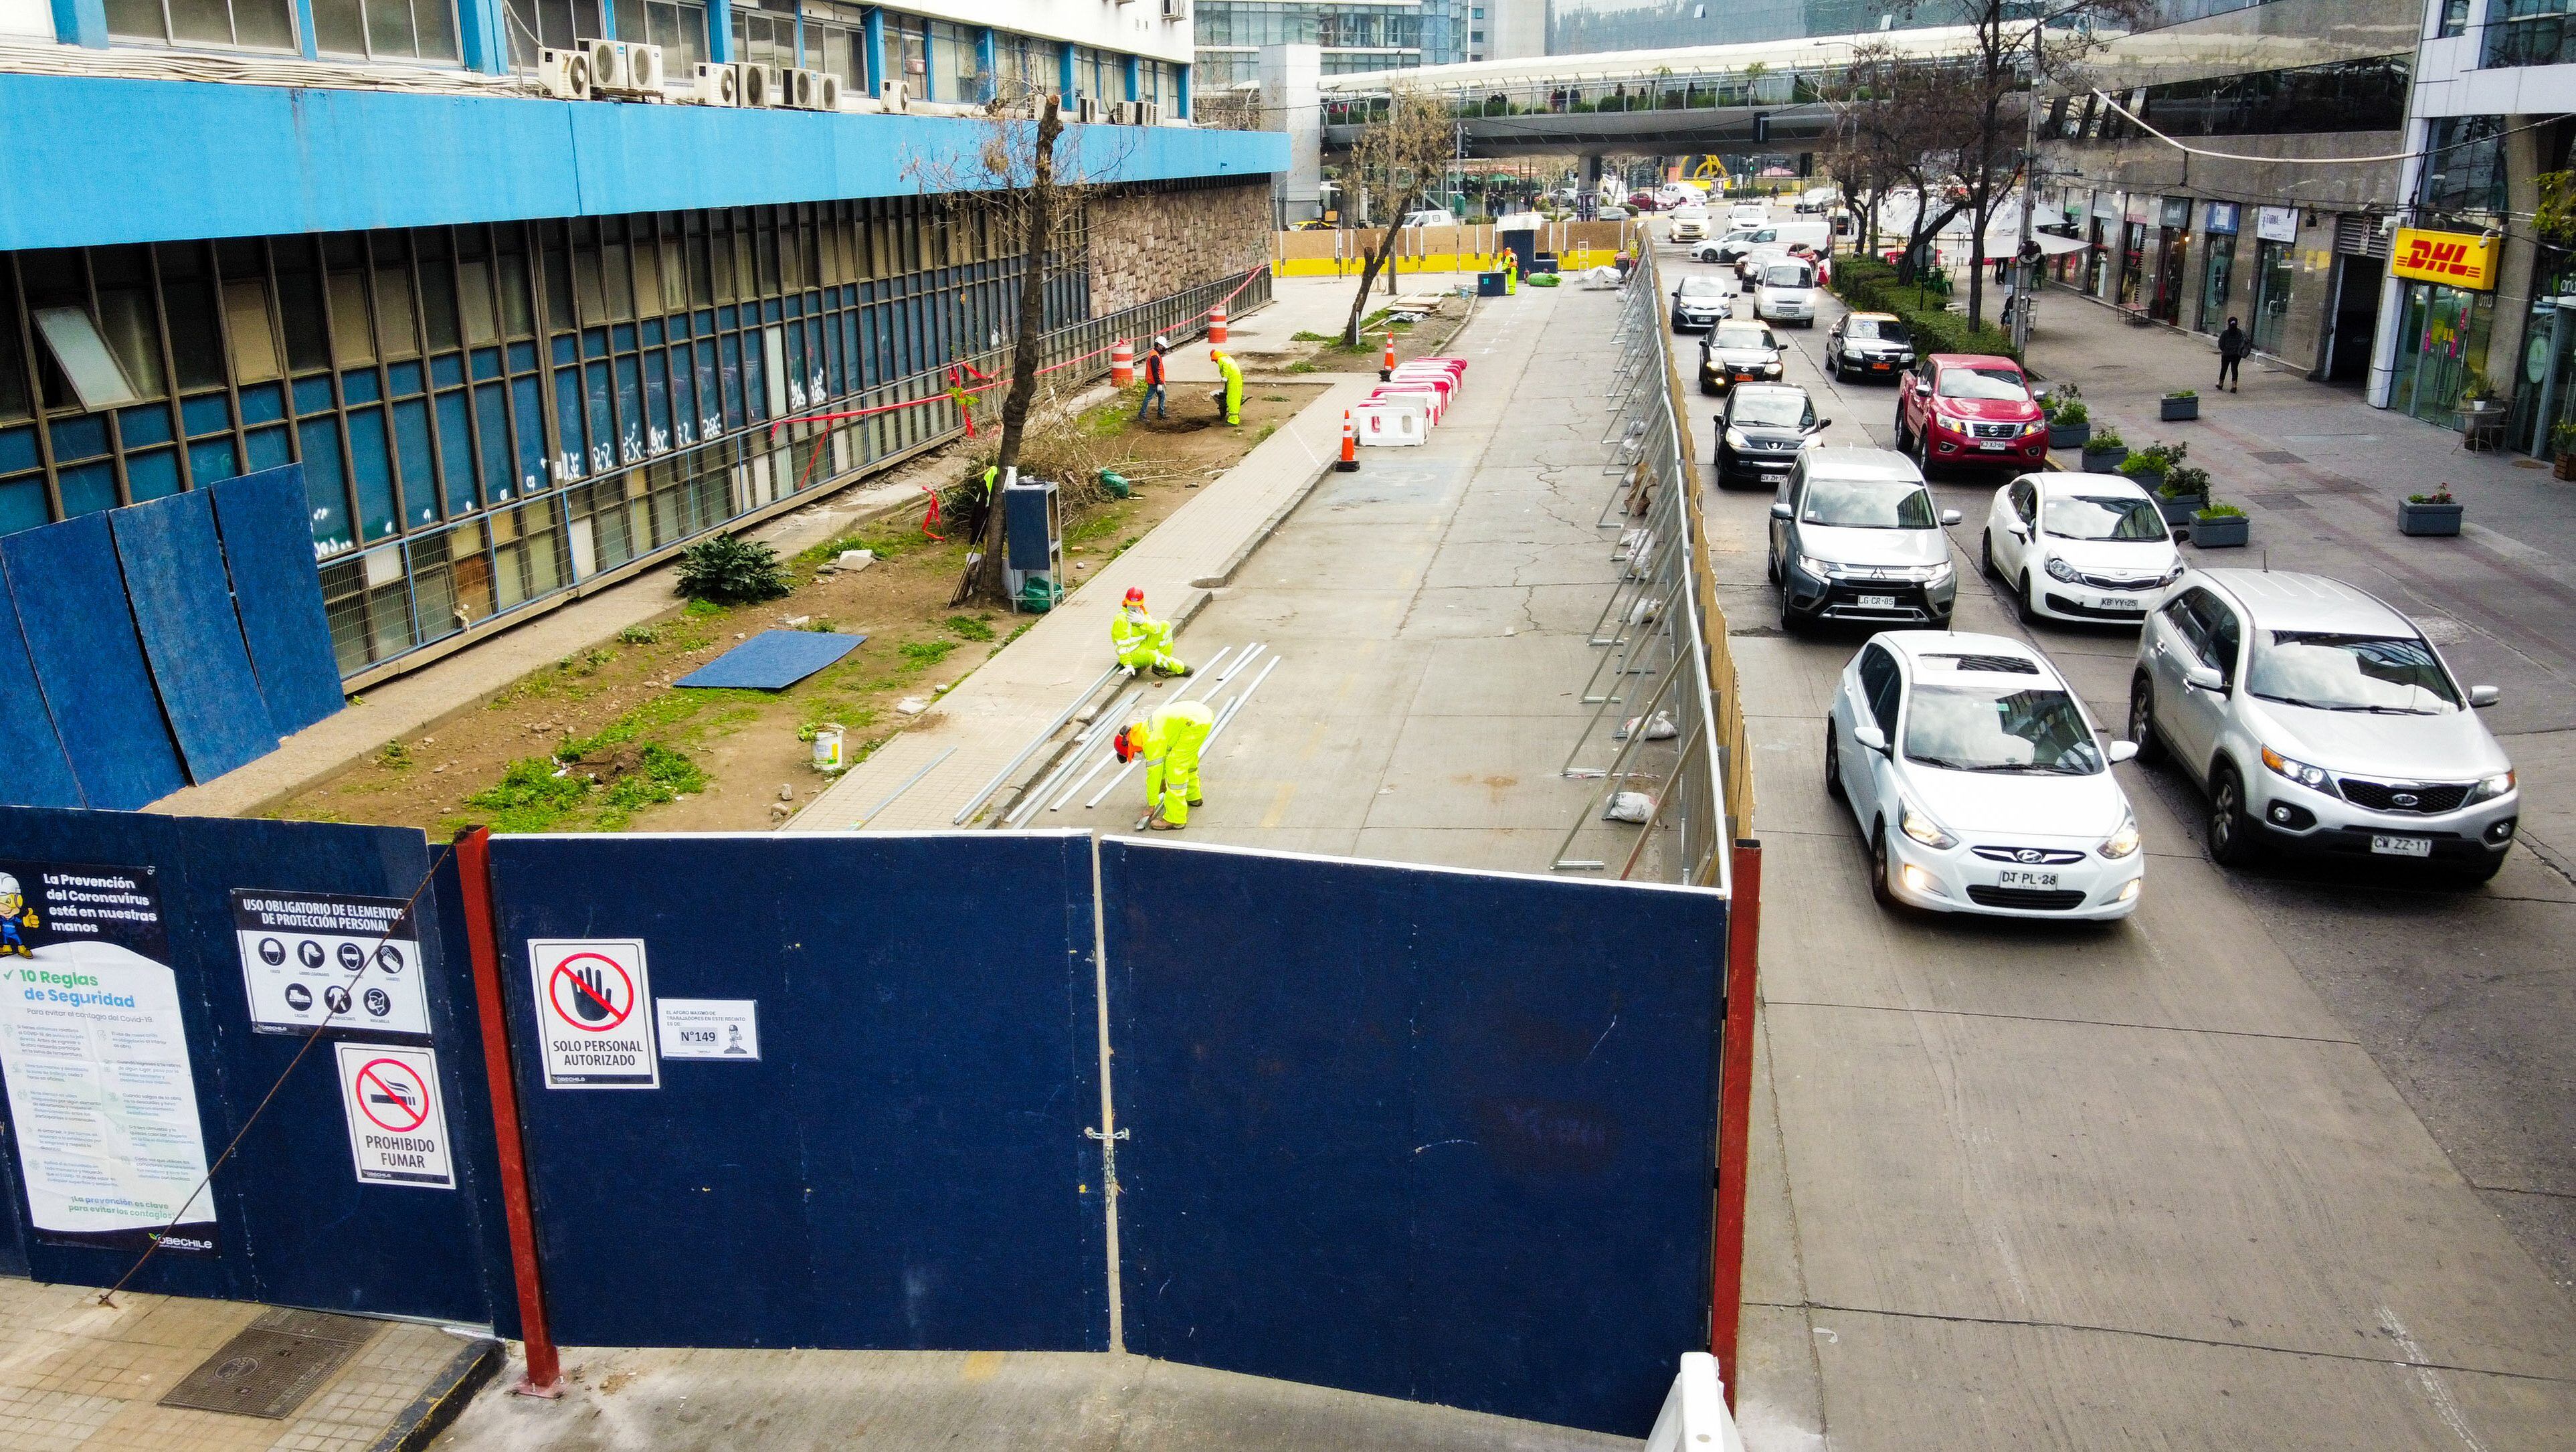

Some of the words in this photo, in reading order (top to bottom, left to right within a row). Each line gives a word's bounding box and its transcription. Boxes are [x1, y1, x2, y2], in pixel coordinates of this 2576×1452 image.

[2407, 239, 2469, 276] DHL
[2478, 294, 2493, 308] 0113
[43, 873, 59, 885] La
[61, 874, 136, 889] Prevención
[46, 889, 67, 901] del
[68, 890, 150, 906] Coronavirus
[49, 905, 78, 917] está
[80, 908, 96, 918] en
[98, 909, 158, 922] nuestras
[243, 898, 264, 911] USO
[266, 900, 331, 916] OBLIGATORIO
[333, 903, 347, 917] DE
[348, 905, 405, 920] ELEMENTOS
[52, 921, 99, 933] manos
[262, 912, 276, 925] DE
[276, 913, 337, 929] PROTECCIÓN
[339, 917, 391, 932] PERSONAL
[19, 969, 35, 983] 10
[39, 970, 99, 989] Reglas
[25, 988, 45, 1002] de
[48, 988, 136, 1008] Seguridad
[27, 1008, 43, 1016] Para
[75, 1012, 107, 1021] contagio
[680, 1030, 716, 1042] N°149
[553, 1040, 582, 1053] SOLO
[584, 1040, 644, 1053] PERSONAL
[563, 1054, 636, 1067] AUTORIZADO
[365, 1135, 435, 1153] PROHIBIDO
[381, 1152, 426, 1169] FUMAR
[85, 1196, 133, 1206] prevención
[68, 1204, 88, 1212] para
[90, 1205, 115, 1213] evitar
[116, 1206, 128, 1215] los
